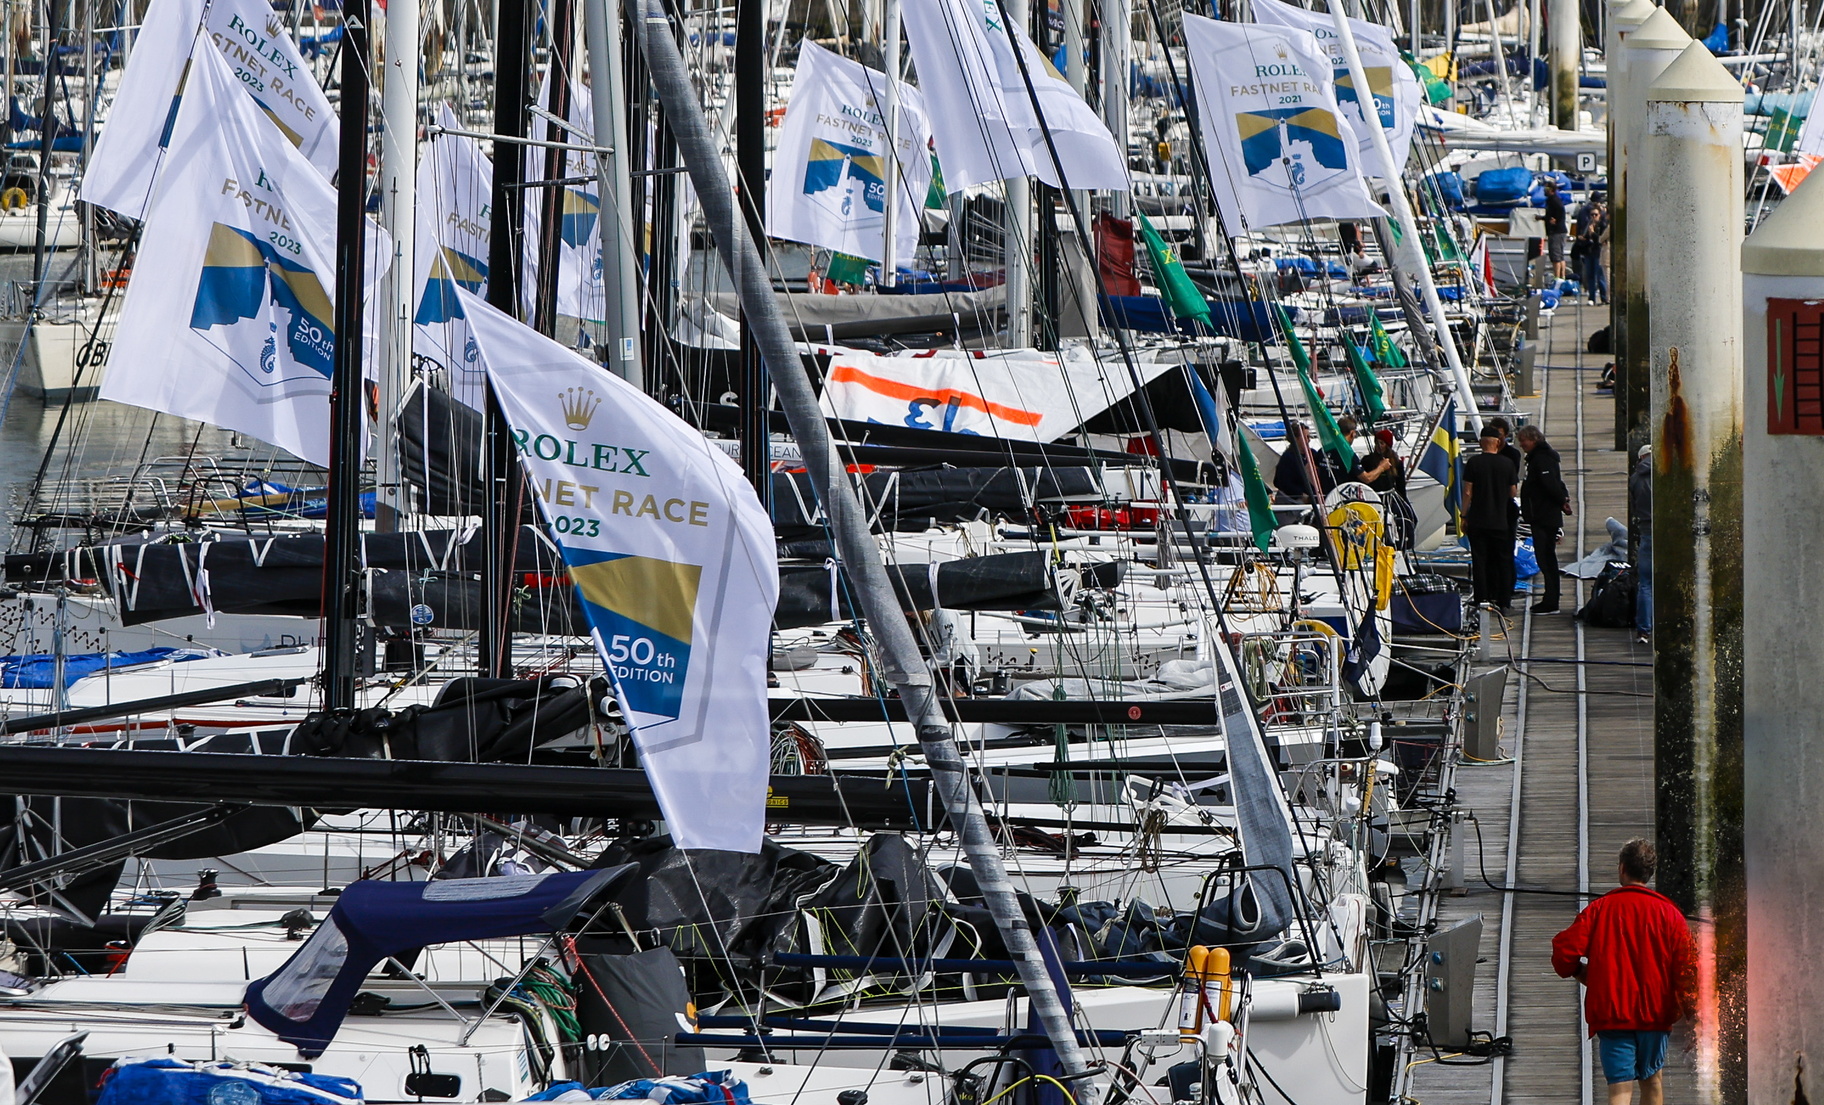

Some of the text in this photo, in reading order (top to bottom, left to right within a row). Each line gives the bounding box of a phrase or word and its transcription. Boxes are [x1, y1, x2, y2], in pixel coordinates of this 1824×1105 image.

[227, 13, 298, 81] ROLEX
[212, 32, 316, 122] STNET RACE
[234, 67, 265, 93] 2023
[1231, 82, 1298, 96] FASTNET
[1373, 98, 1390, 109] 0th
[816, 114, 874, 137] FASTNET
[850, 135, 873, 148] 2023
[1583, 157, 1590, 167] P
[868, 182, 884, 195] 50
[269, 231, 302, 255] 2023
[294, 331, 331, 361] EDITION
[297, 317, 334, 352] 50th
[512, 427, 650, 477] ROLEX
[612, 490, 709, 527] RACE
[549, 515, 600, 537] 023
[609, 635, 675, 668] 50th
